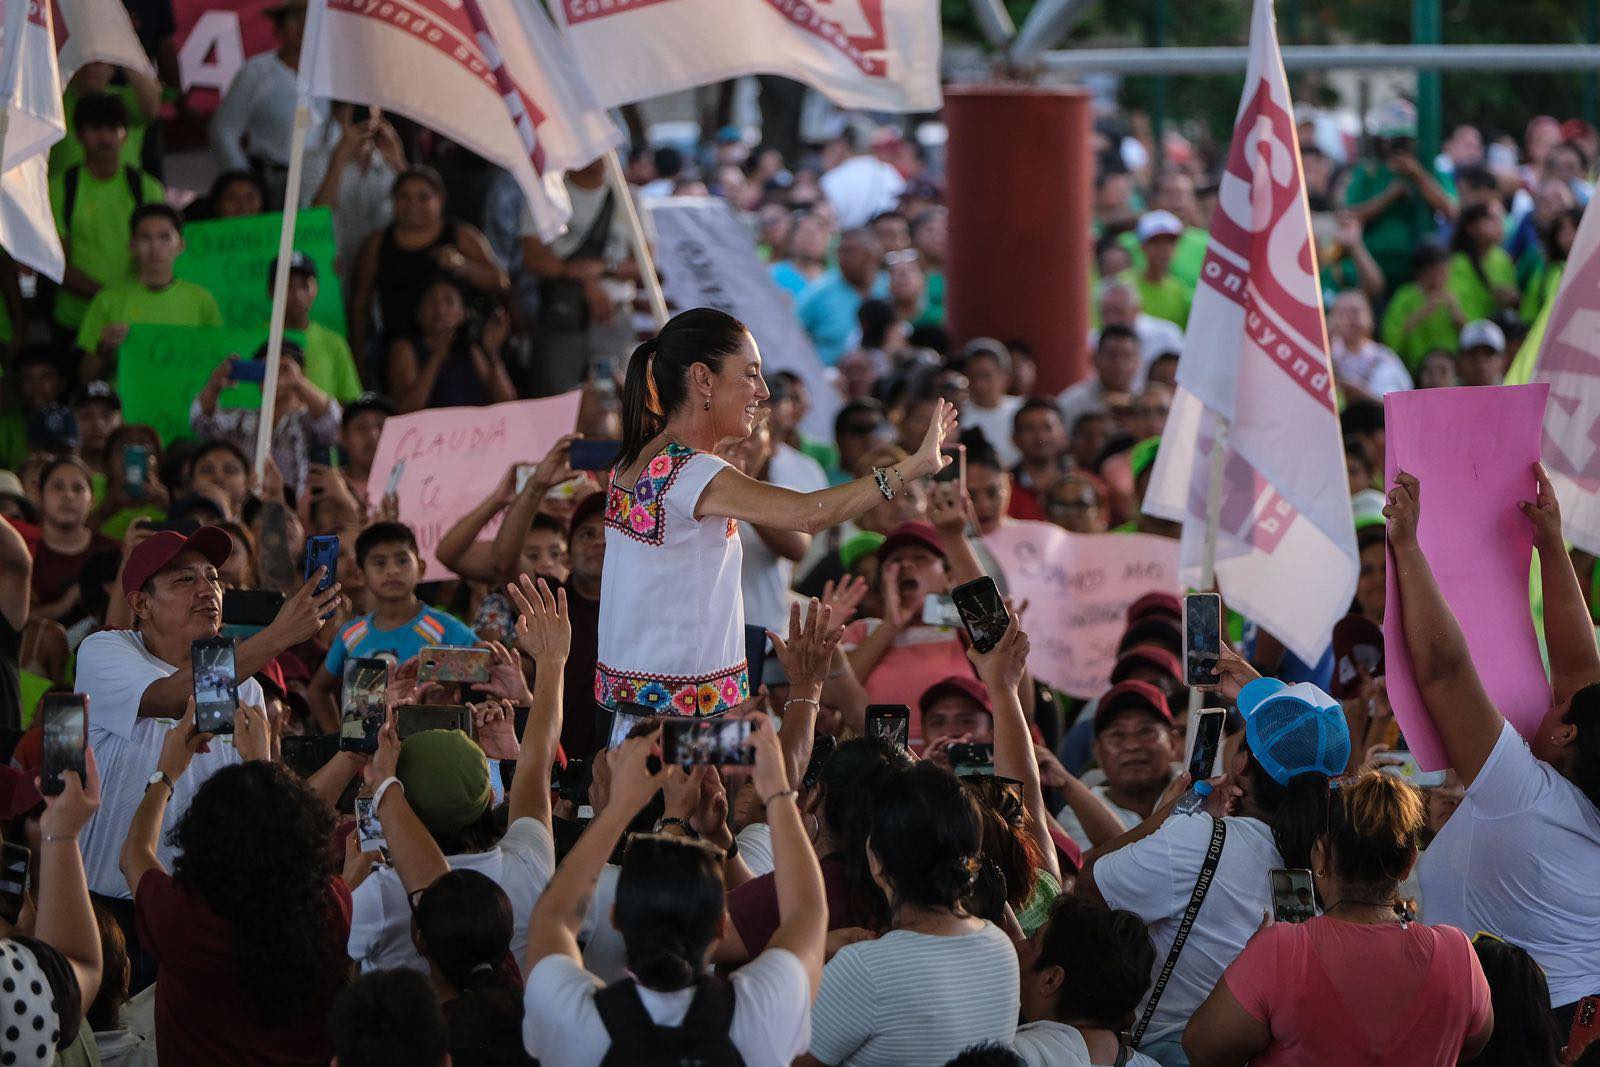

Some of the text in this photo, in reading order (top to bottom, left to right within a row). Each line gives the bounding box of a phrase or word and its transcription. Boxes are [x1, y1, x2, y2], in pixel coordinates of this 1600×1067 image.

[1173, 905, 1198, 954] FOREVER
[1193, 867, 1213, 904] YOUNG
[1208, 818, 1225, 861] FOREVE
